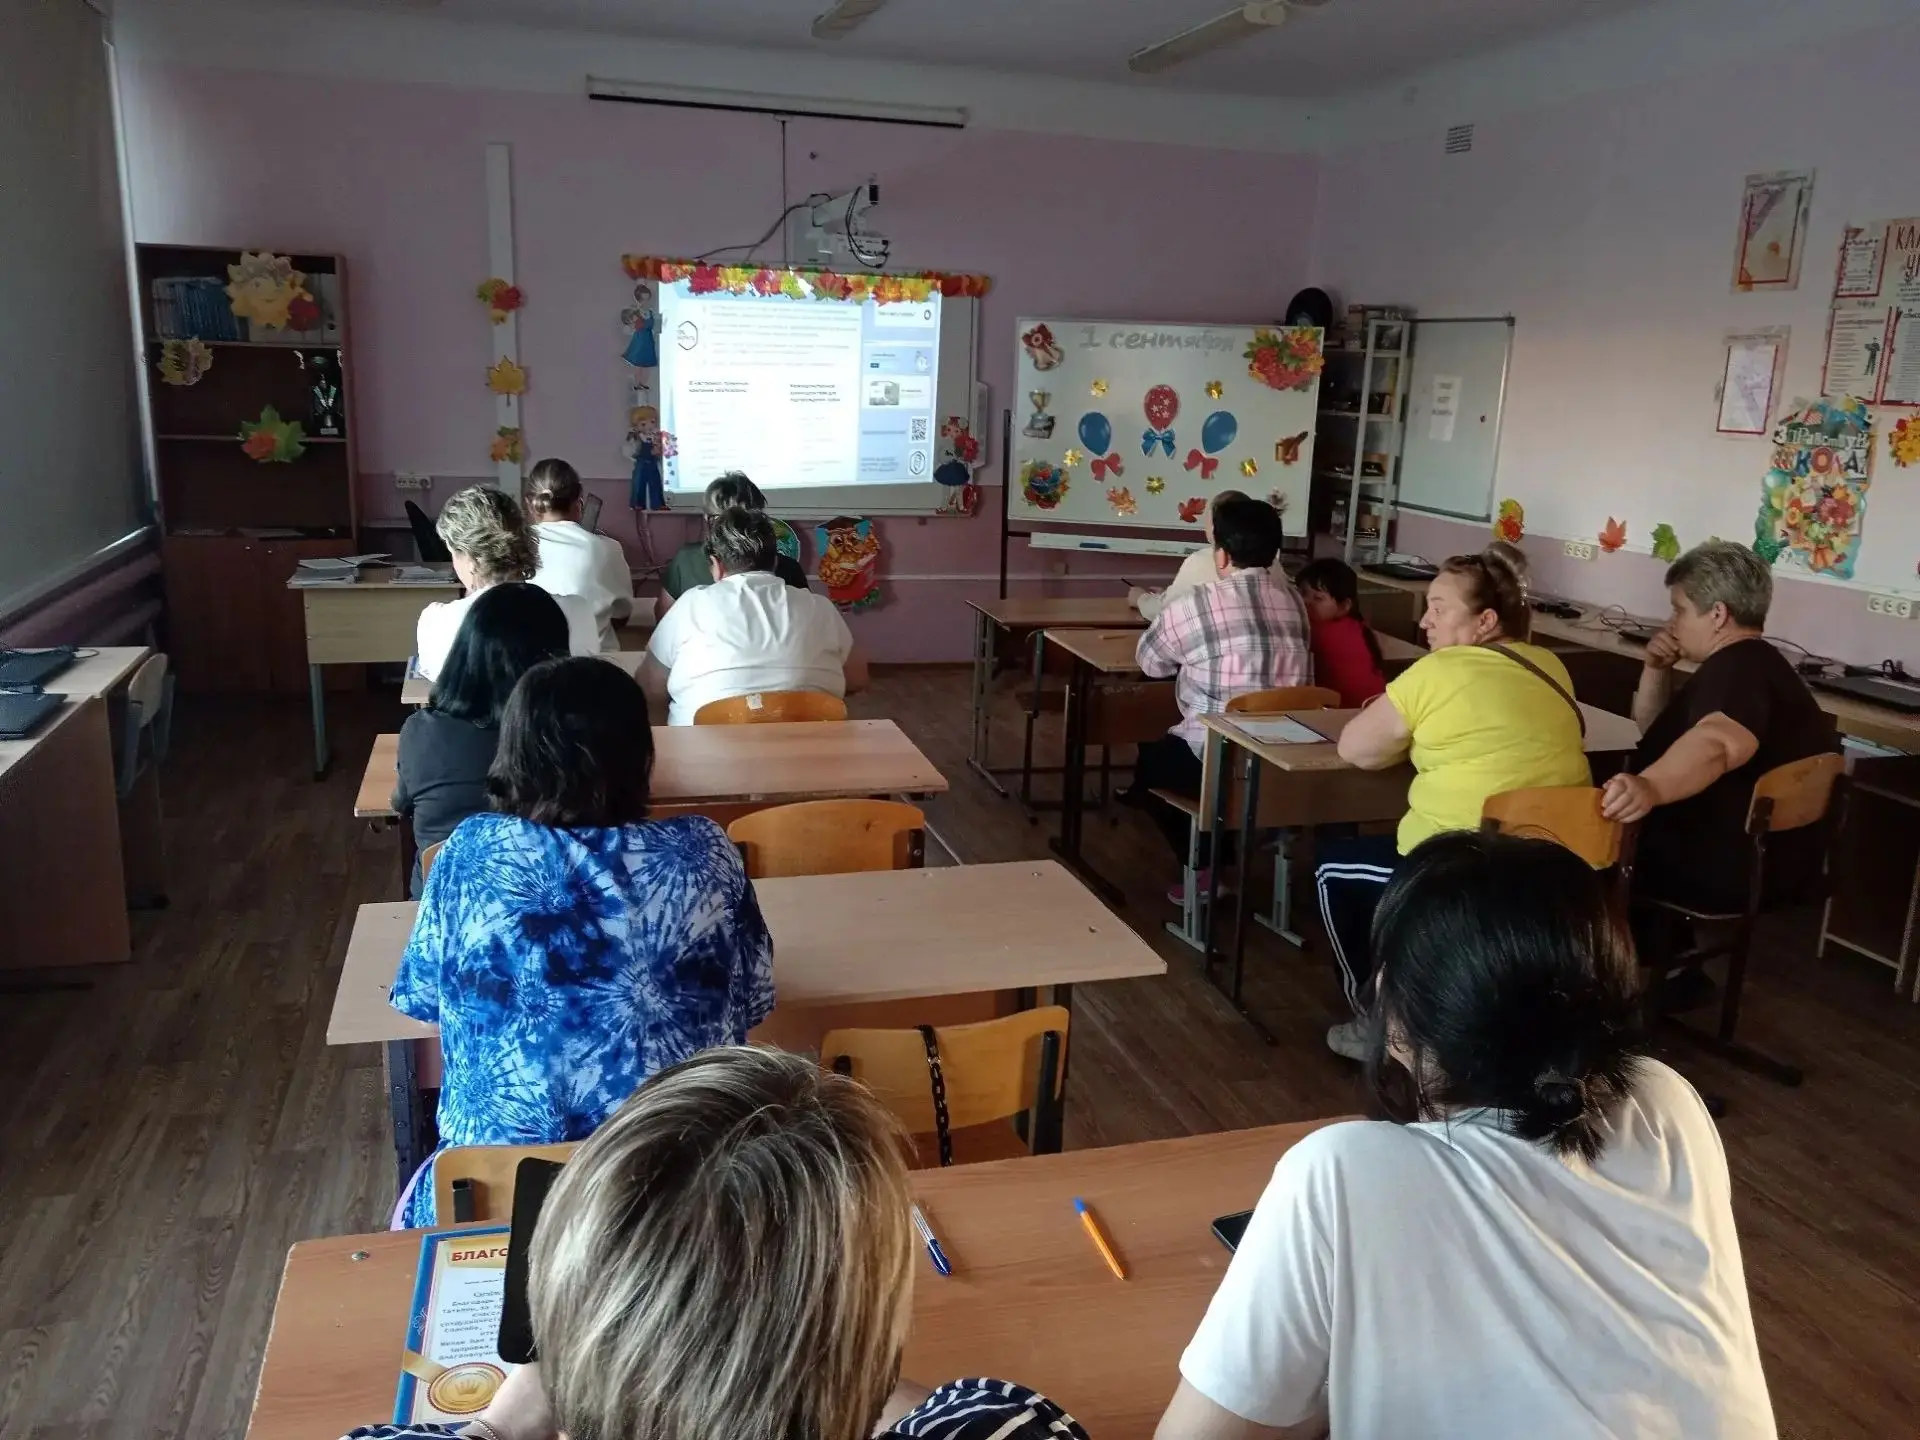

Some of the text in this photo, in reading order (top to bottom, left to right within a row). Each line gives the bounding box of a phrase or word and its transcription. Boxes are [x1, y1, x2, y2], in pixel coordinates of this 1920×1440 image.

[1895, 225, 1920, 250] КЛ
[1079, 325, 1235, 357] 1 сентября
